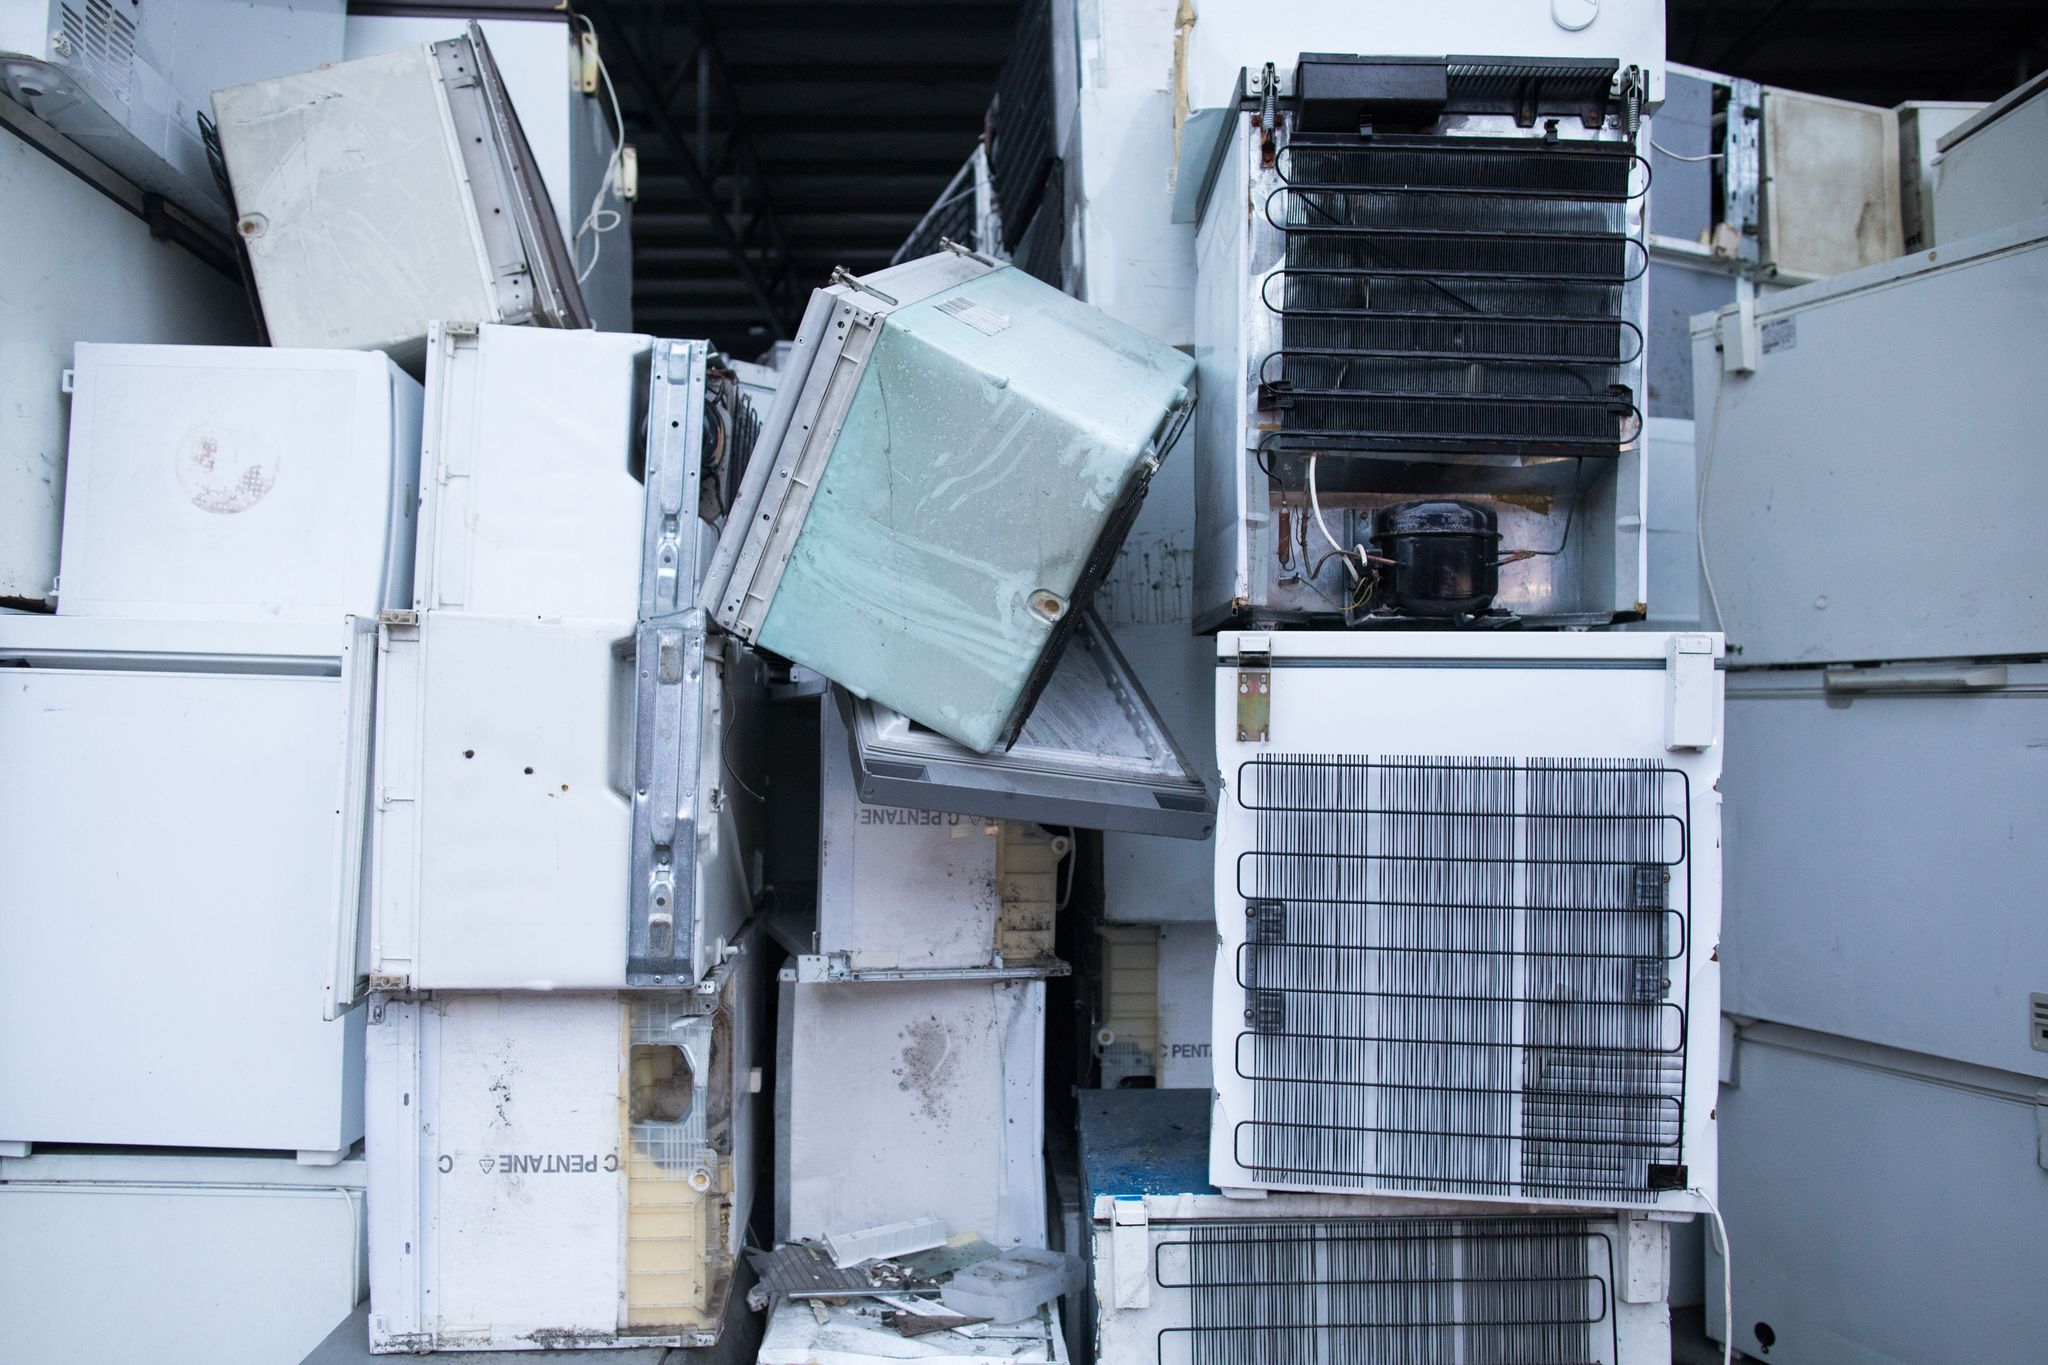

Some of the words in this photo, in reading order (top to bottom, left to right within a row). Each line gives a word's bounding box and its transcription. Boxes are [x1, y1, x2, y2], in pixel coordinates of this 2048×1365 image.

[860, 809, 942, 825] PENTANE
[948, 812, 960, 826] C
[1172, 1043, 1212, 1058] PENT
[438, 1154, 453, 1174] C
[499, 1154, 598, 1173] PENTANE
[604, 1153, 619, 1173] C
